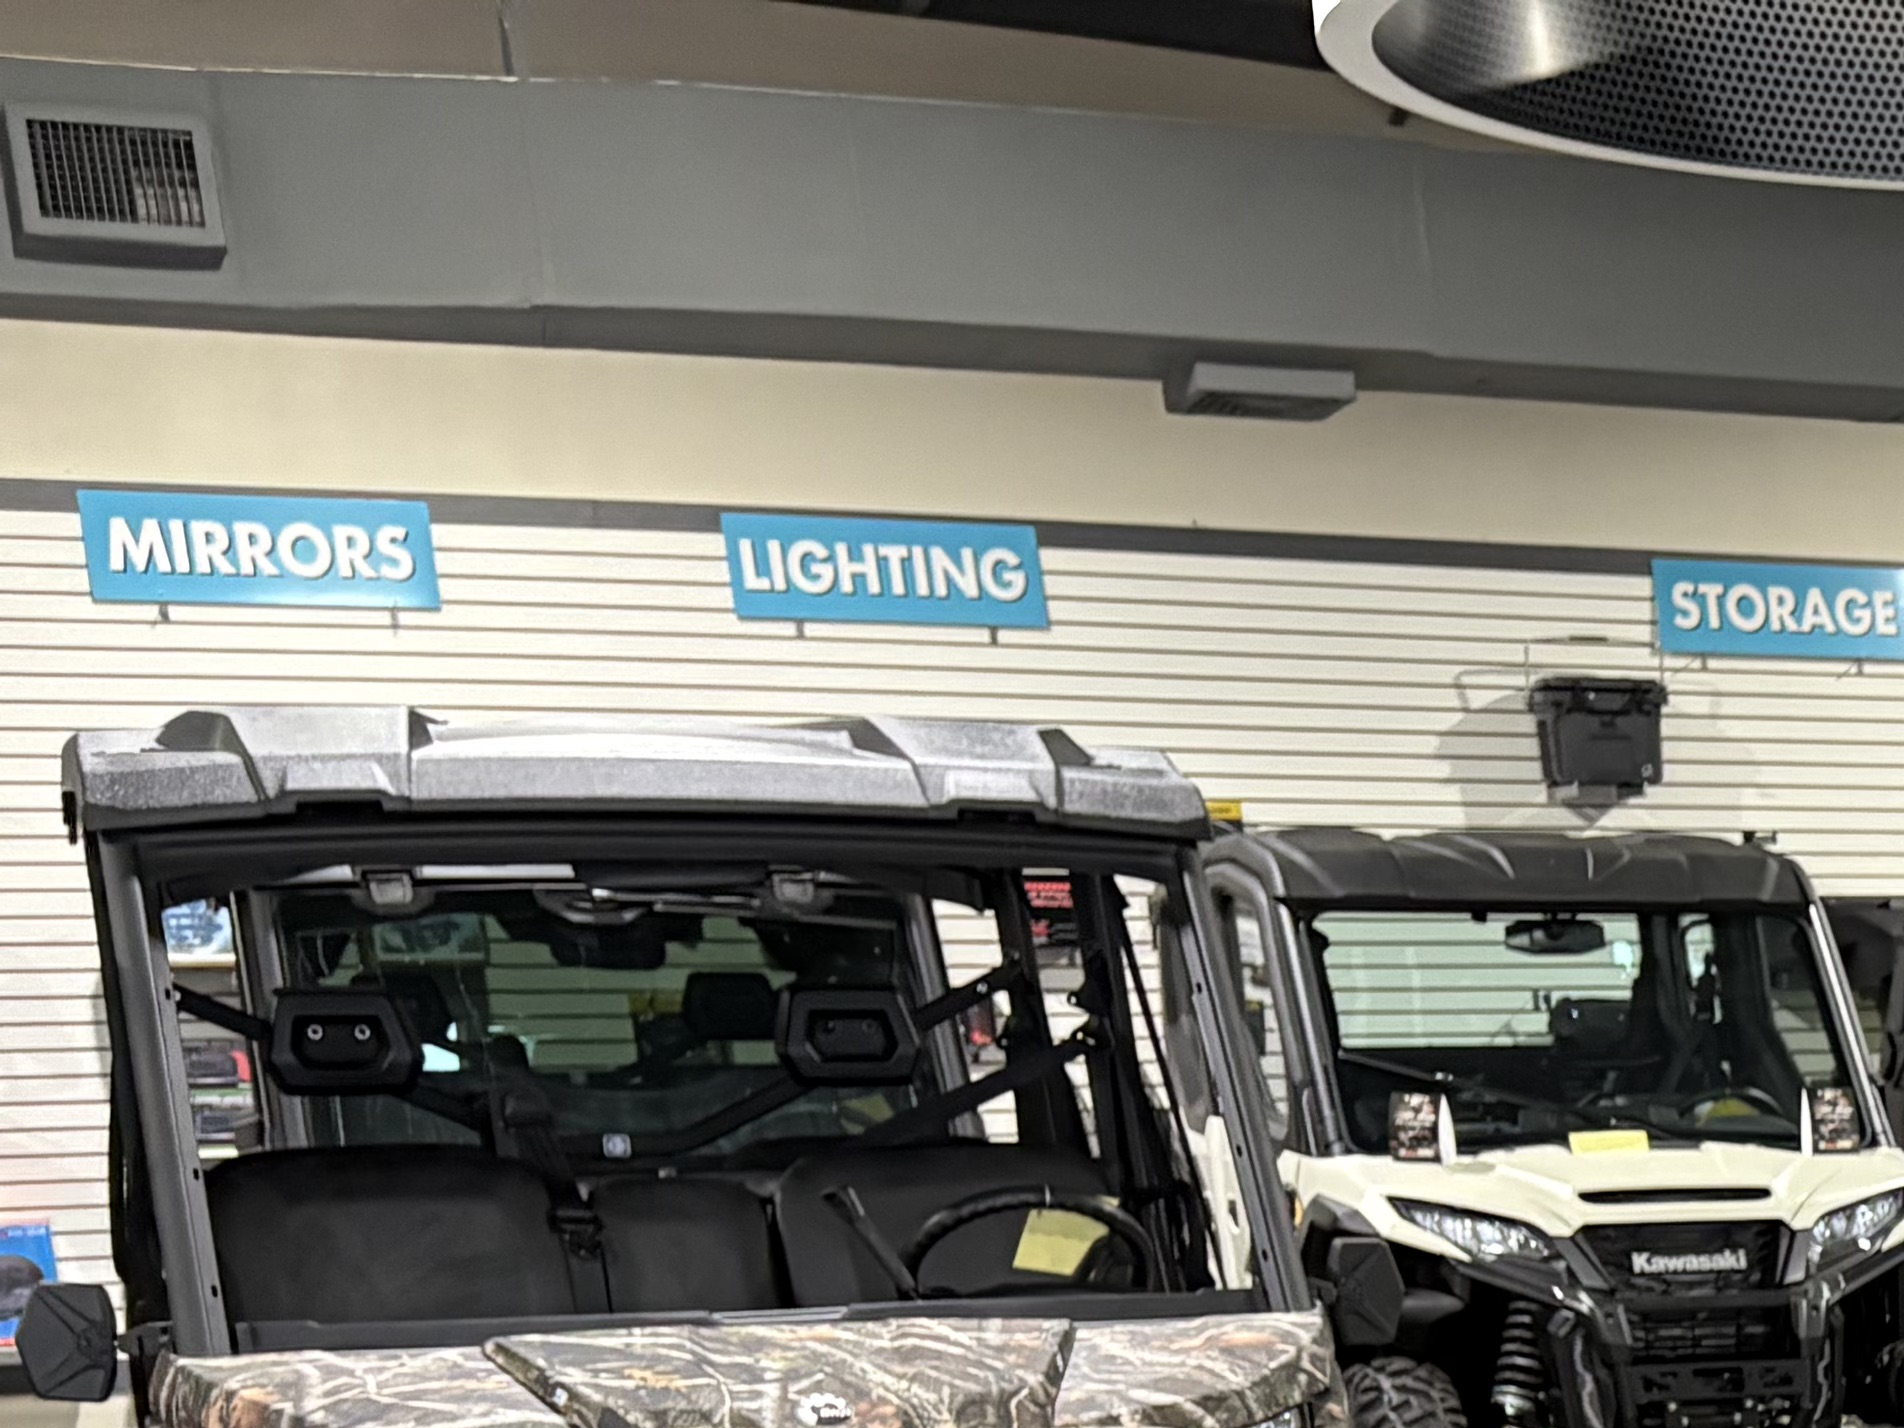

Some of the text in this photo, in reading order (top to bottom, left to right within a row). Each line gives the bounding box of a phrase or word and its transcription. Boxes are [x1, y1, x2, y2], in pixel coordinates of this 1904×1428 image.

[108, 516, 416, 582] MIRRORS
[738, 537, 1029, 602] LIGHTING
[1671, 580, 1899, 636] STORAGE
[1631, 1247, 1748, 1275] Kawasaki
